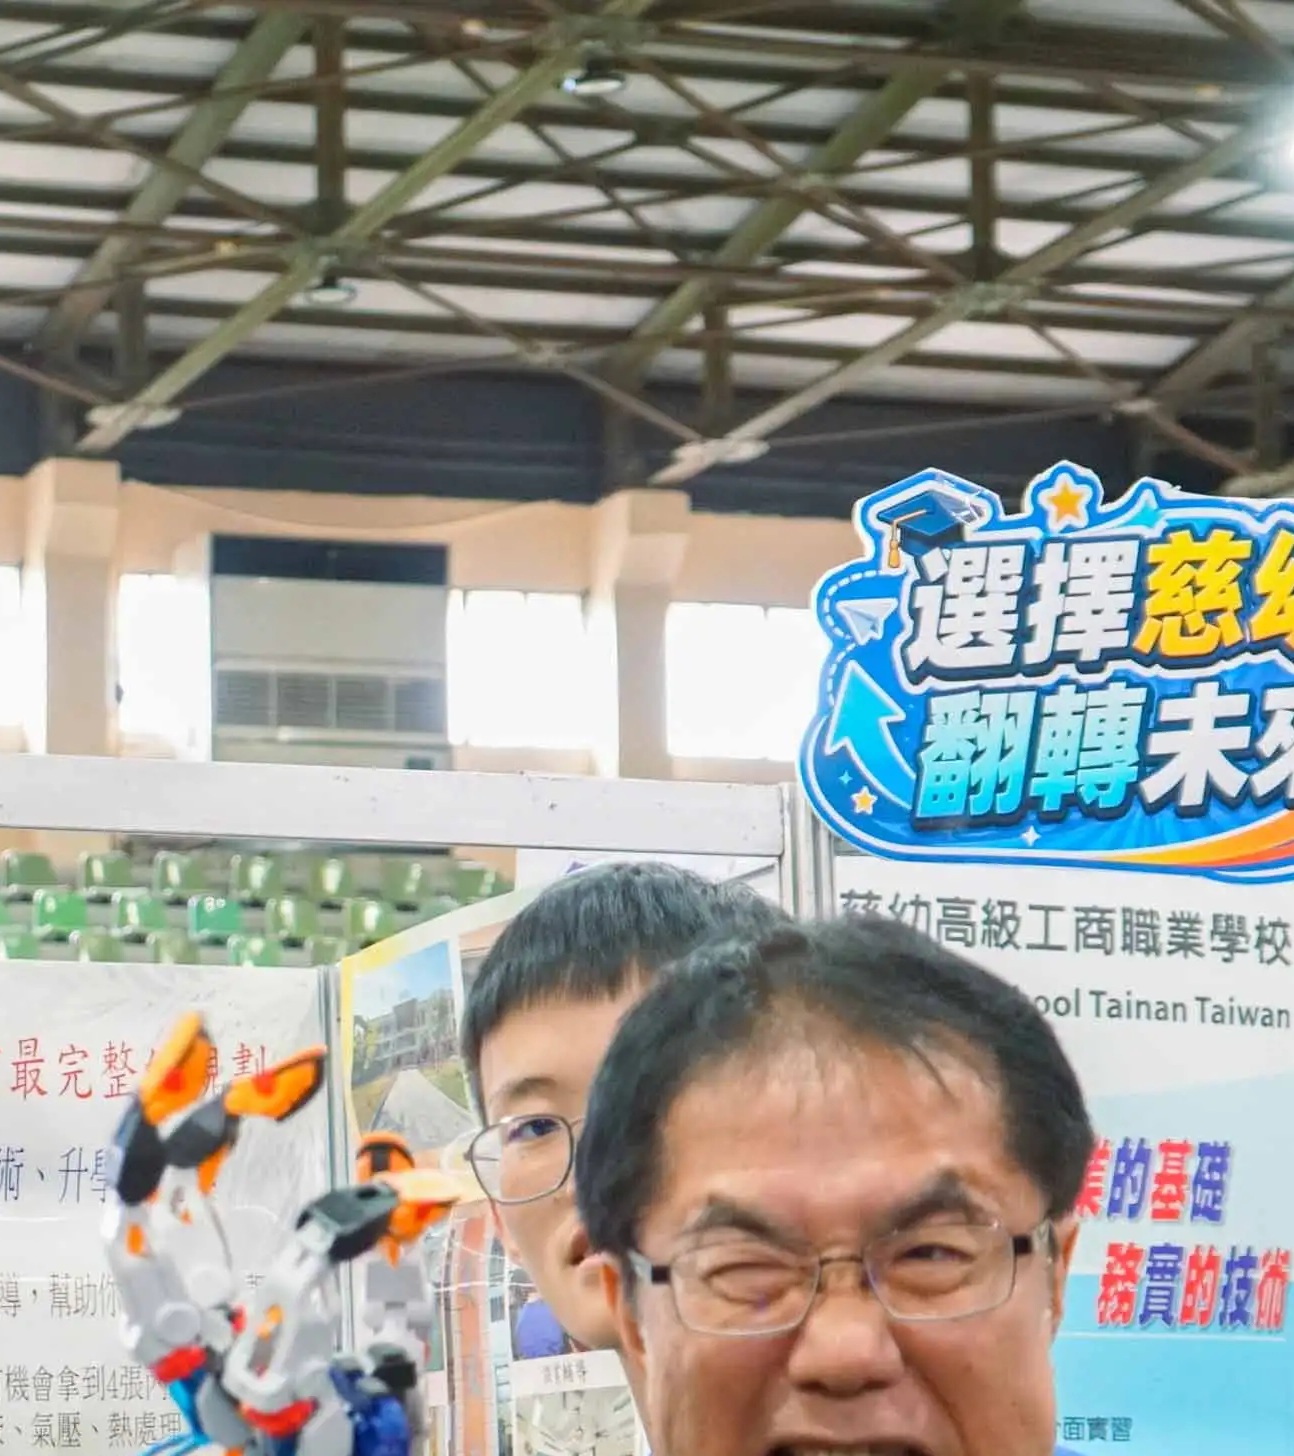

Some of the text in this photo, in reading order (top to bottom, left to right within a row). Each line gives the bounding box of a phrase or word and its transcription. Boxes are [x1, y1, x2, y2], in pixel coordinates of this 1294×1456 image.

[1088, 991, 1188, 1025] Tainan
[1194, 996, 1292, 1030] Taiwan
[1096, 1241, 1291, 1331] 務實的技術
[1056, 1416, 1133, 1443] 面實習
